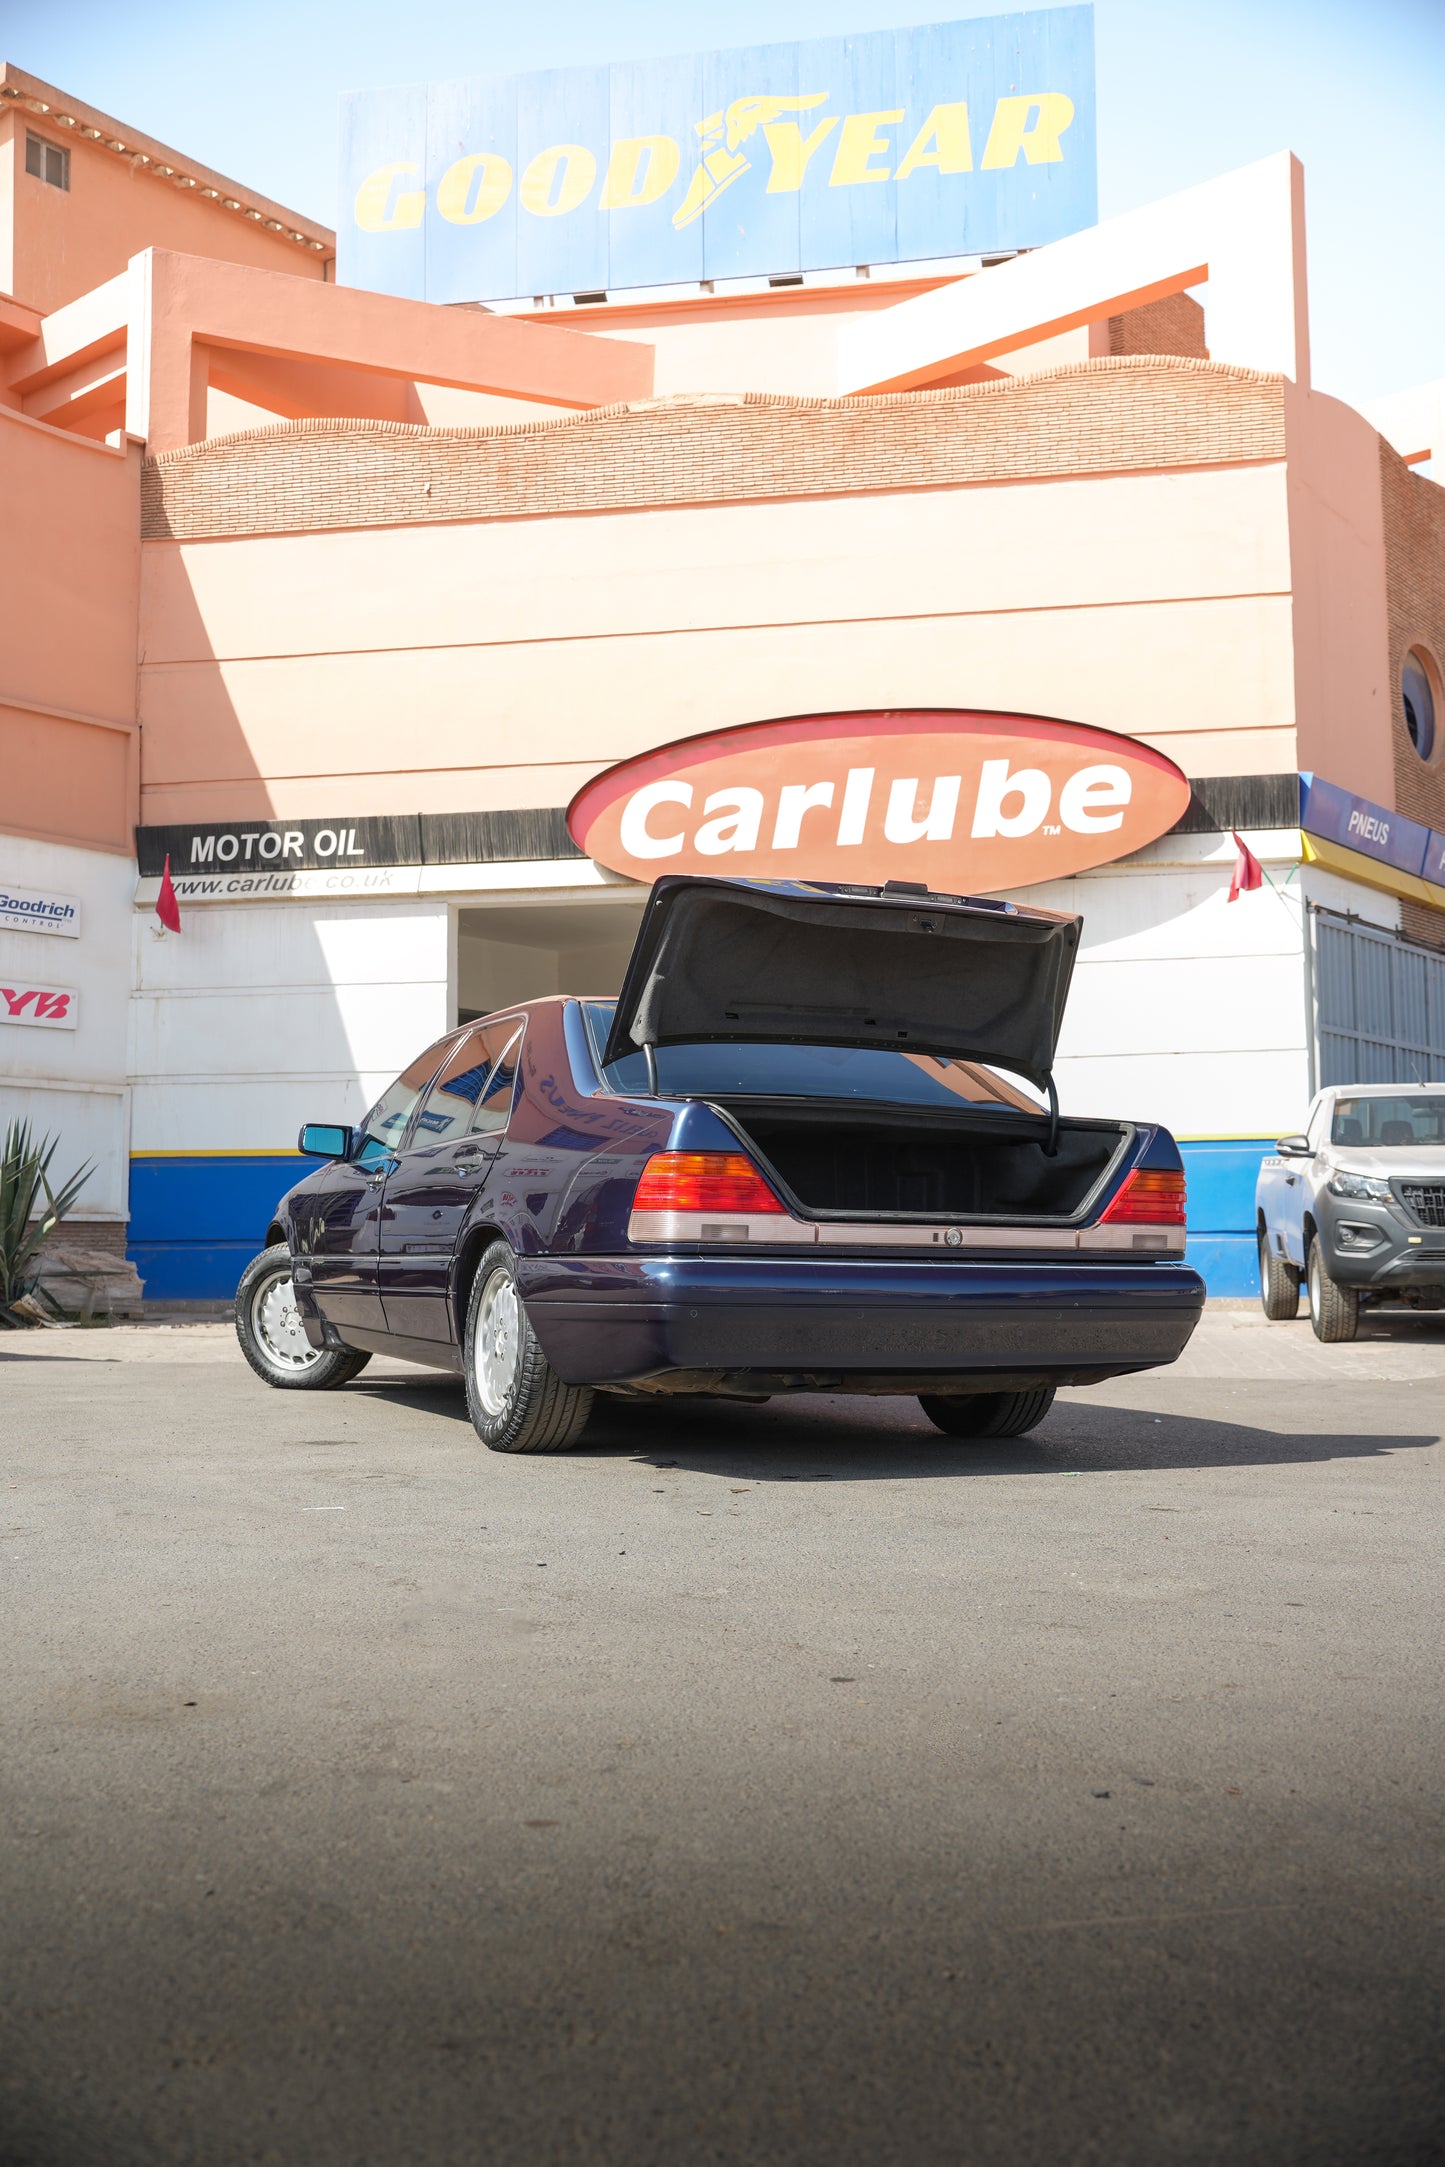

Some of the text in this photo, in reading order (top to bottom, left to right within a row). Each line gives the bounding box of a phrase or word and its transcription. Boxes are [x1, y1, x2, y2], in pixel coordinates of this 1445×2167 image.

[619, 758, 1133, 860] Carlube
[1042, 824, 1061, 836] TM
[1348, 810, 1390, 845] PNEUS
[190, 829, 365, 864] MOTOR OIL
[5, 915, 61, 929] CONTROL
[0, 988, 71, 1019] YB
